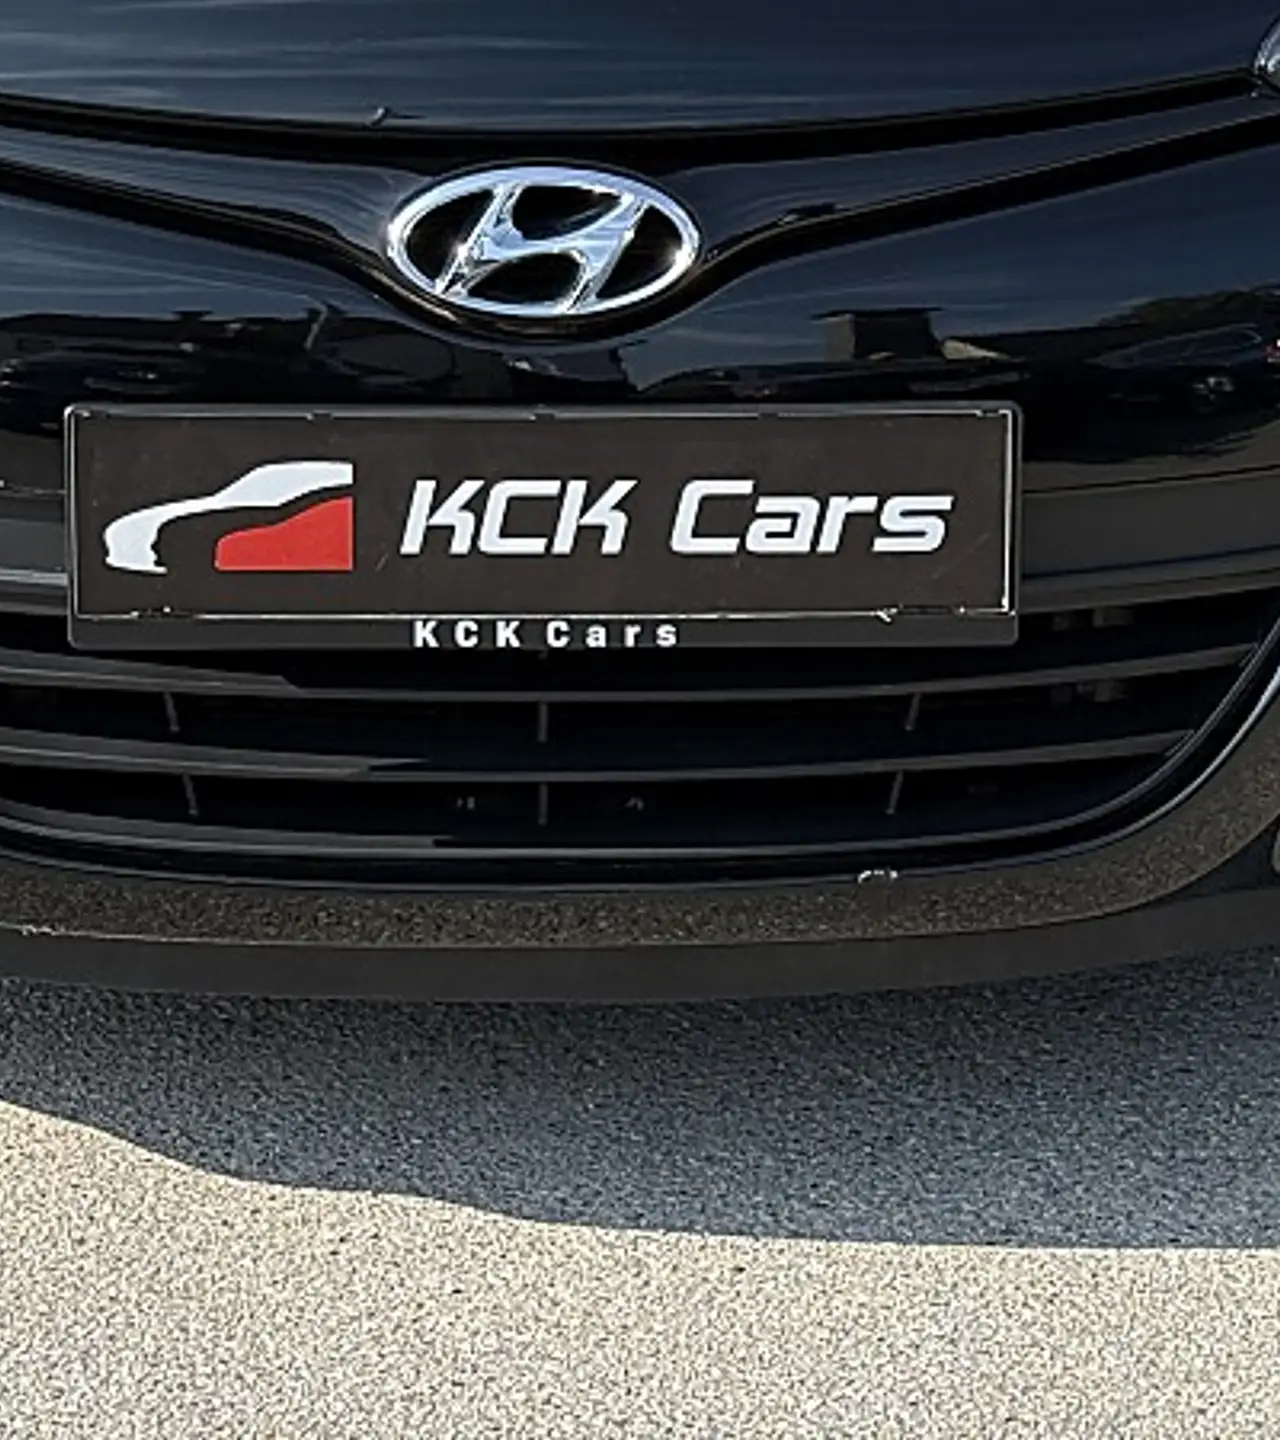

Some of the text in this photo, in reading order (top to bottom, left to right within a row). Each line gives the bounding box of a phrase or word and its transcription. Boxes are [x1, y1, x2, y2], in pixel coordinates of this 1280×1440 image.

[399, 479, 954, 555] KCK Cars
[413, 619, 678, 649] KCK Cars
